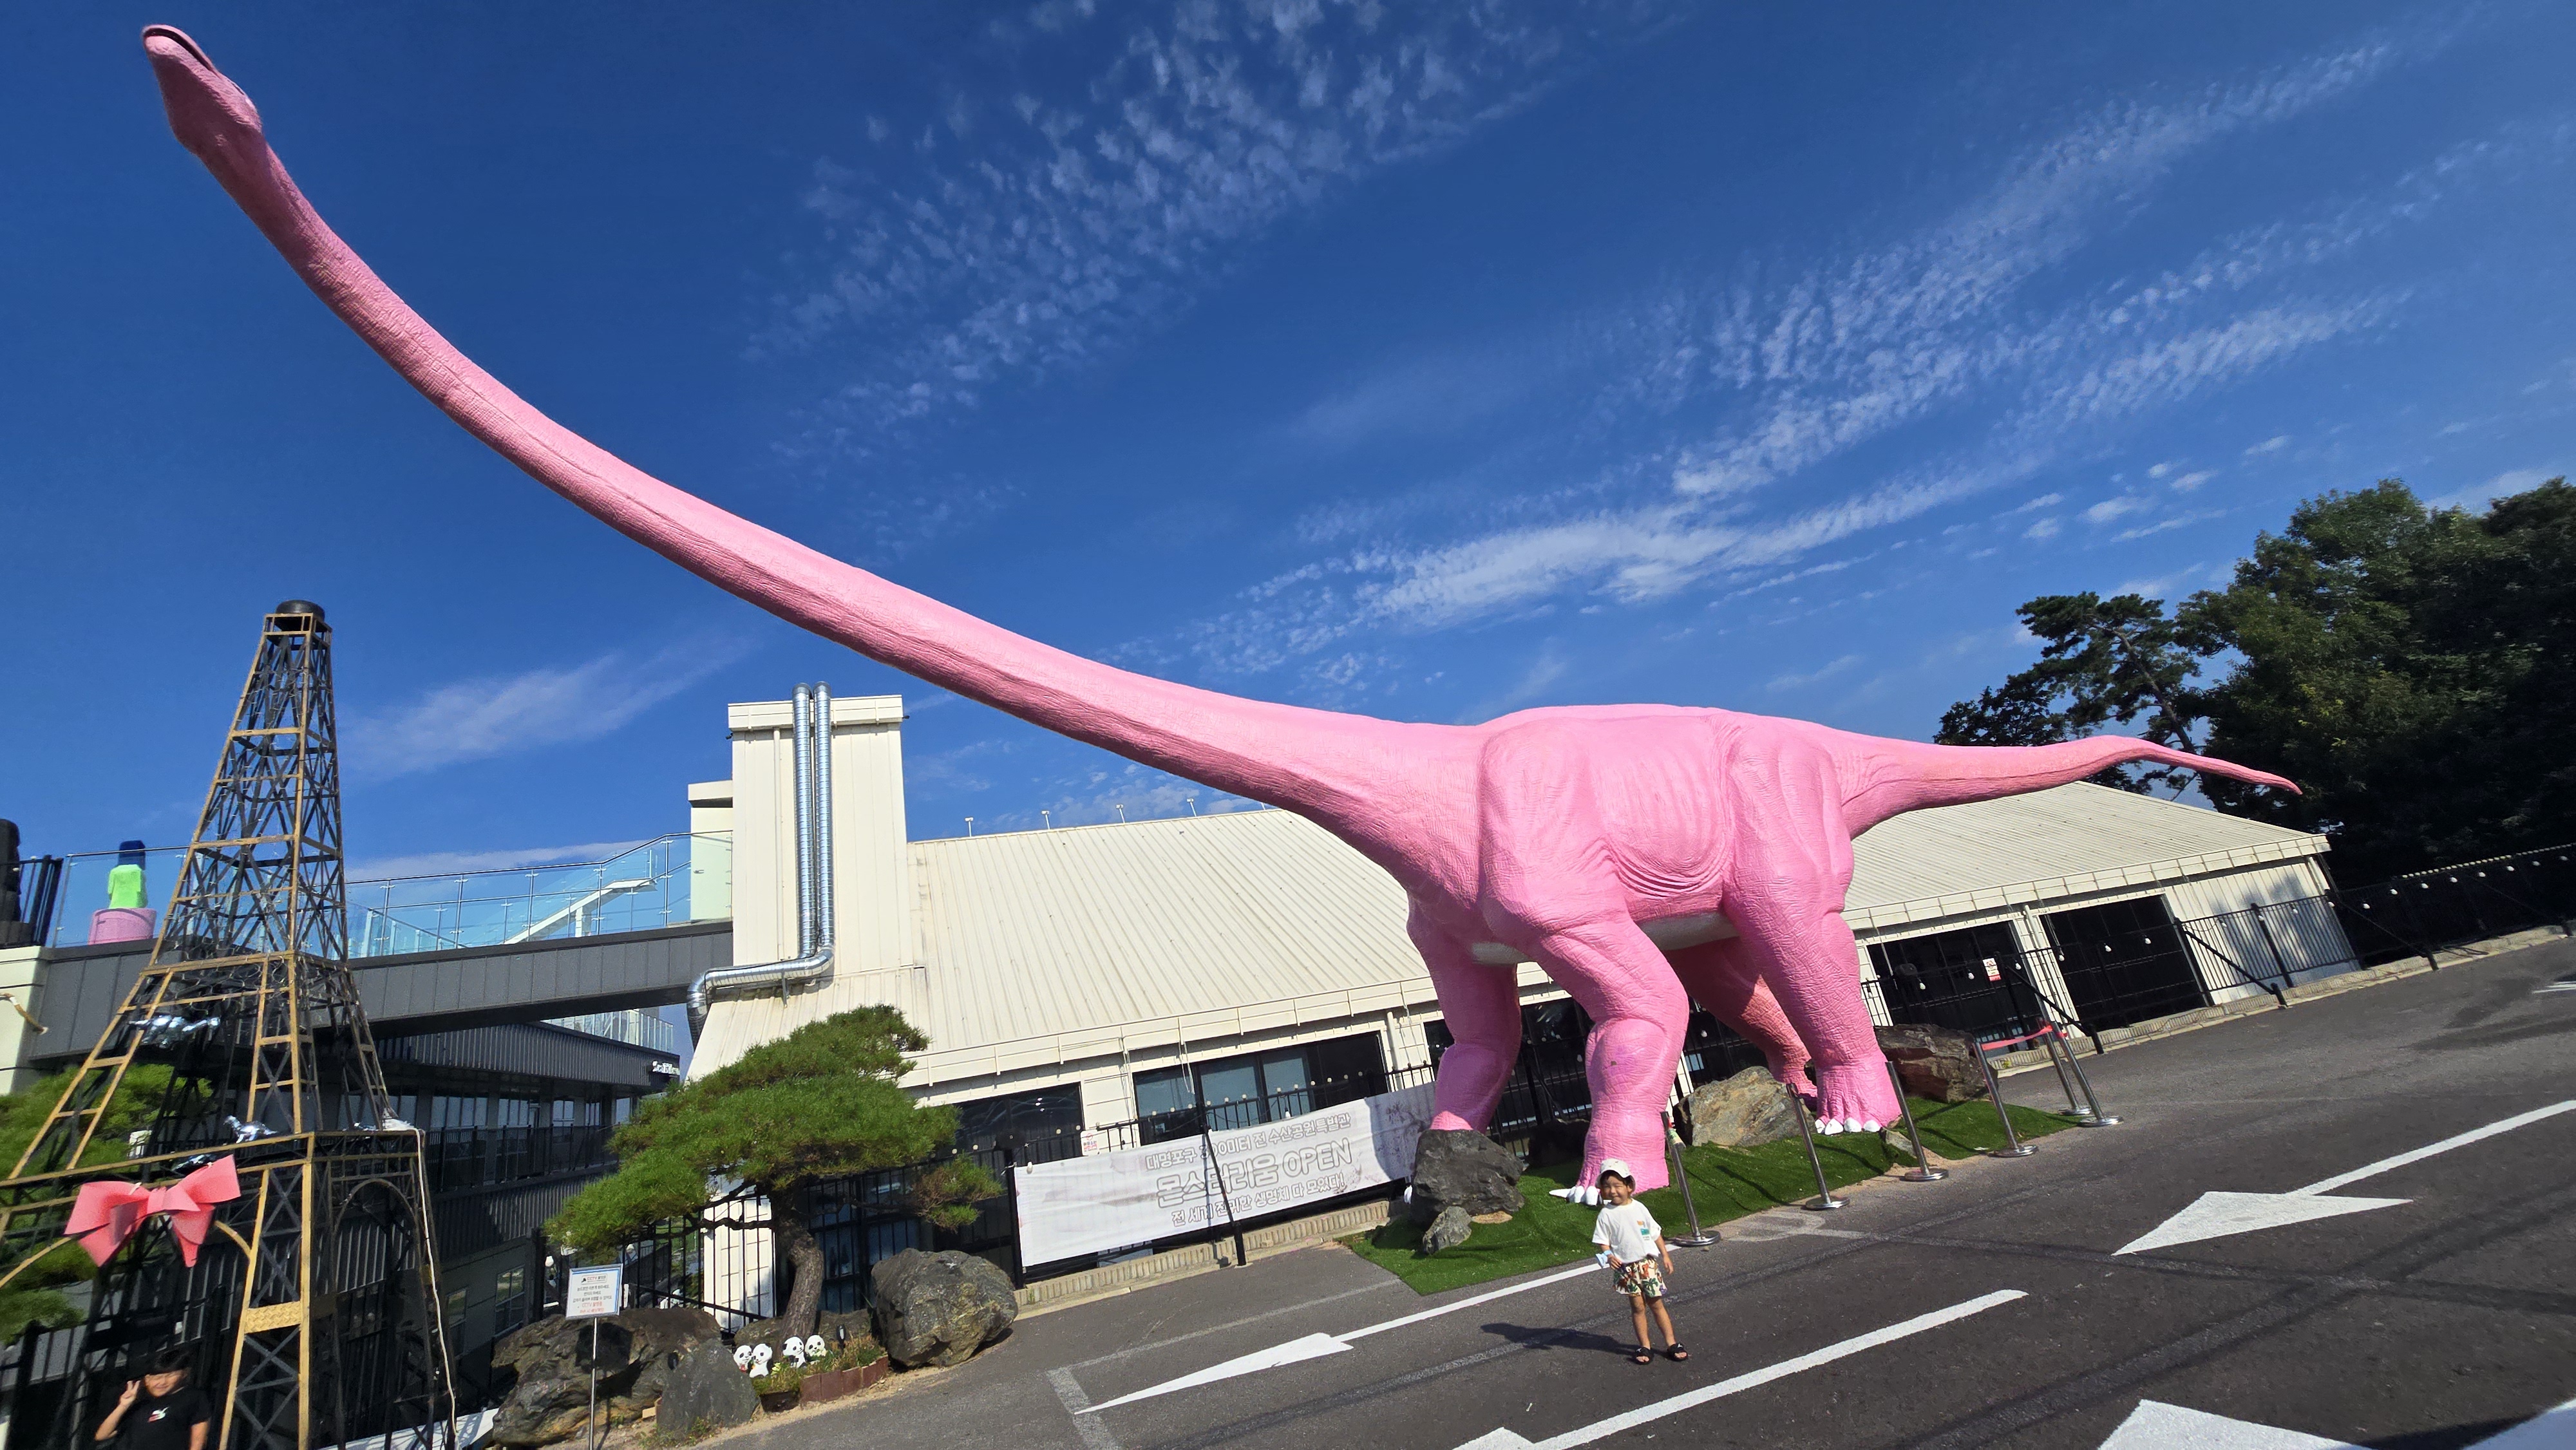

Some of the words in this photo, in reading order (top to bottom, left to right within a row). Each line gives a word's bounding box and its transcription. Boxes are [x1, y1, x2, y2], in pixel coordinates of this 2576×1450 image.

[1146, 1147, 1197, 1171] 대명포구
[1253, 1131, 1267, 1149] 전
[1269, 1112, 1351, 1144] 수산공원특별관
[1157, 1153, 1278, 1208] 몬스터리움
[1282, 1137, 1352, 1177] OPEN
[1171, 1209, 1186, 1227] 전
[1188, 1203, 1213, 1223] 세계
[1215, 1194, 1252, 1217] 진귀한
[1255, 1185, 1290, 1207] 생명체
[1291, 1182, 1304, 1198] 다
[1306, 1172, 1345, 1194] 모였다!
